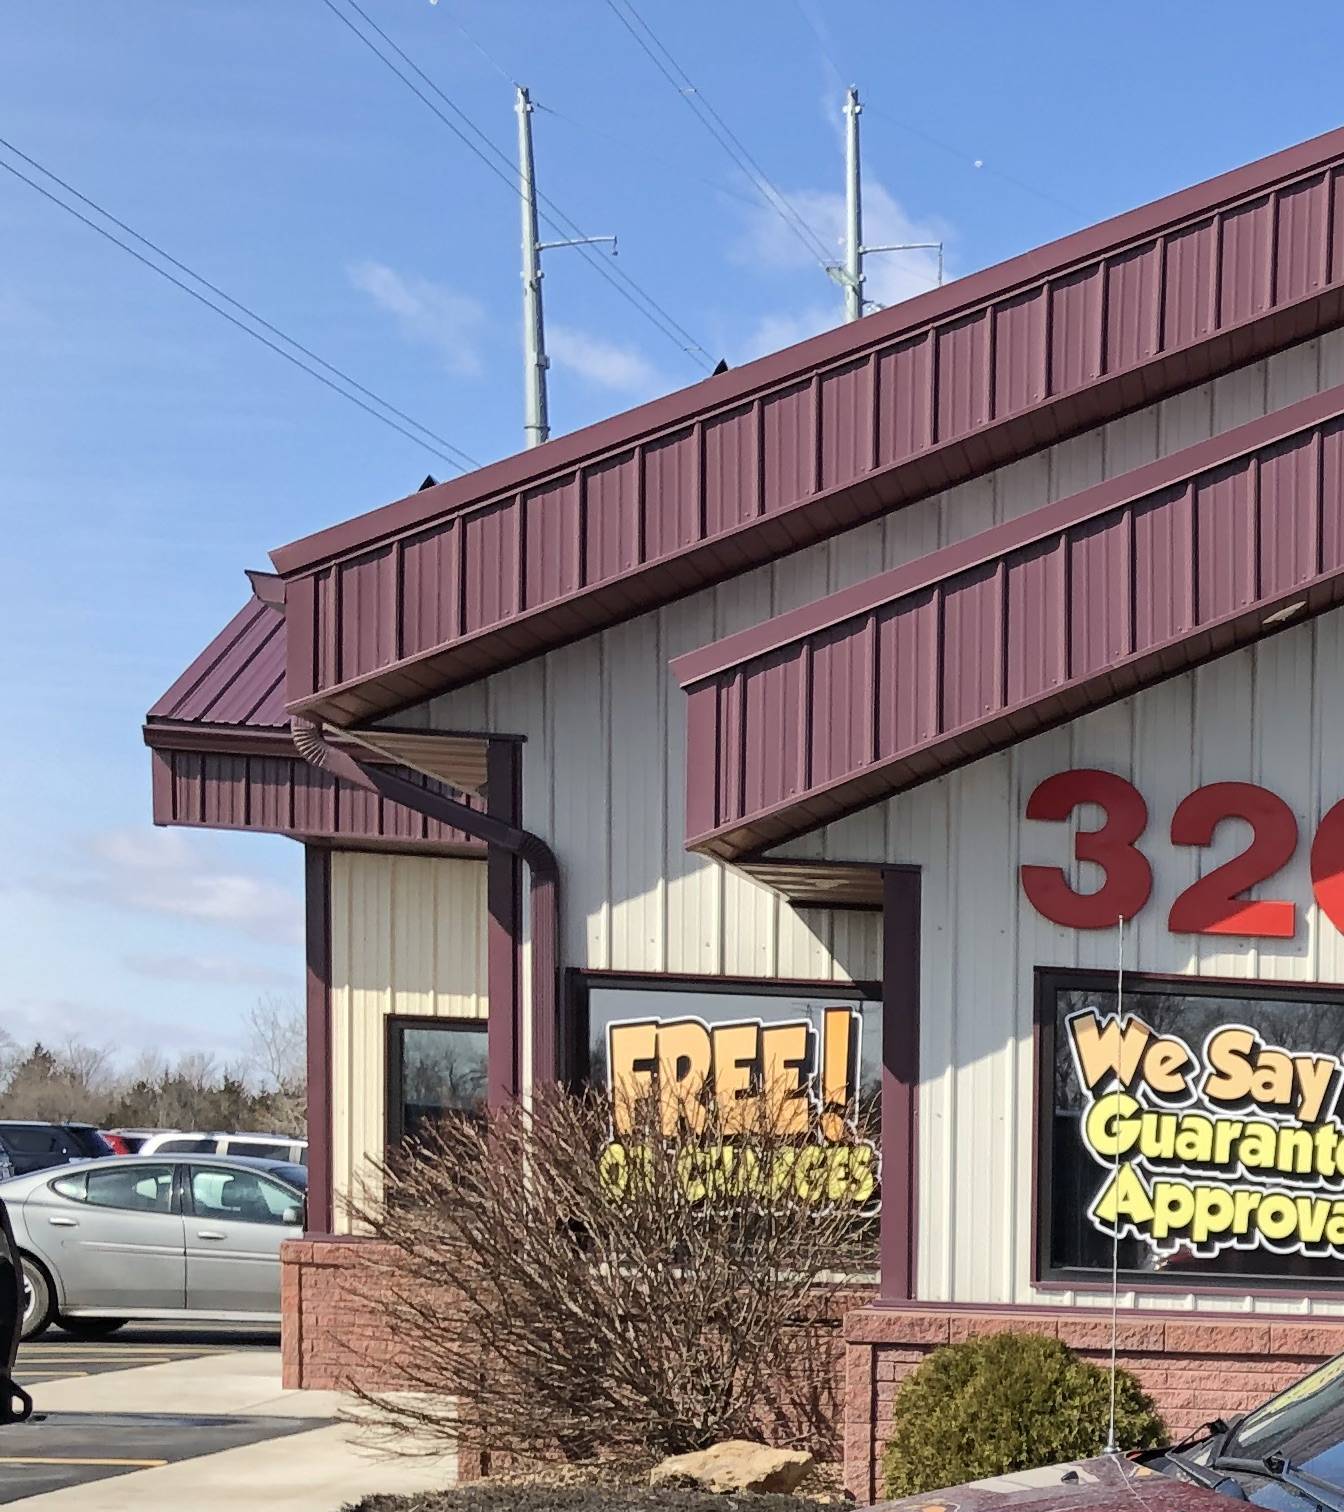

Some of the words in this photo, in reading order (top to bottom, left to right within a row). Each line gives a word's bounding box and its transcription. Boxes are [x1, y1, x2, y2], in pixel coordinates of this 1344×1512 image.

[610, 1006, 854, 1142] FREE!
[1073, 1012, 1189, 1095] We
[1204, 1029, 1335, 1122] Say
